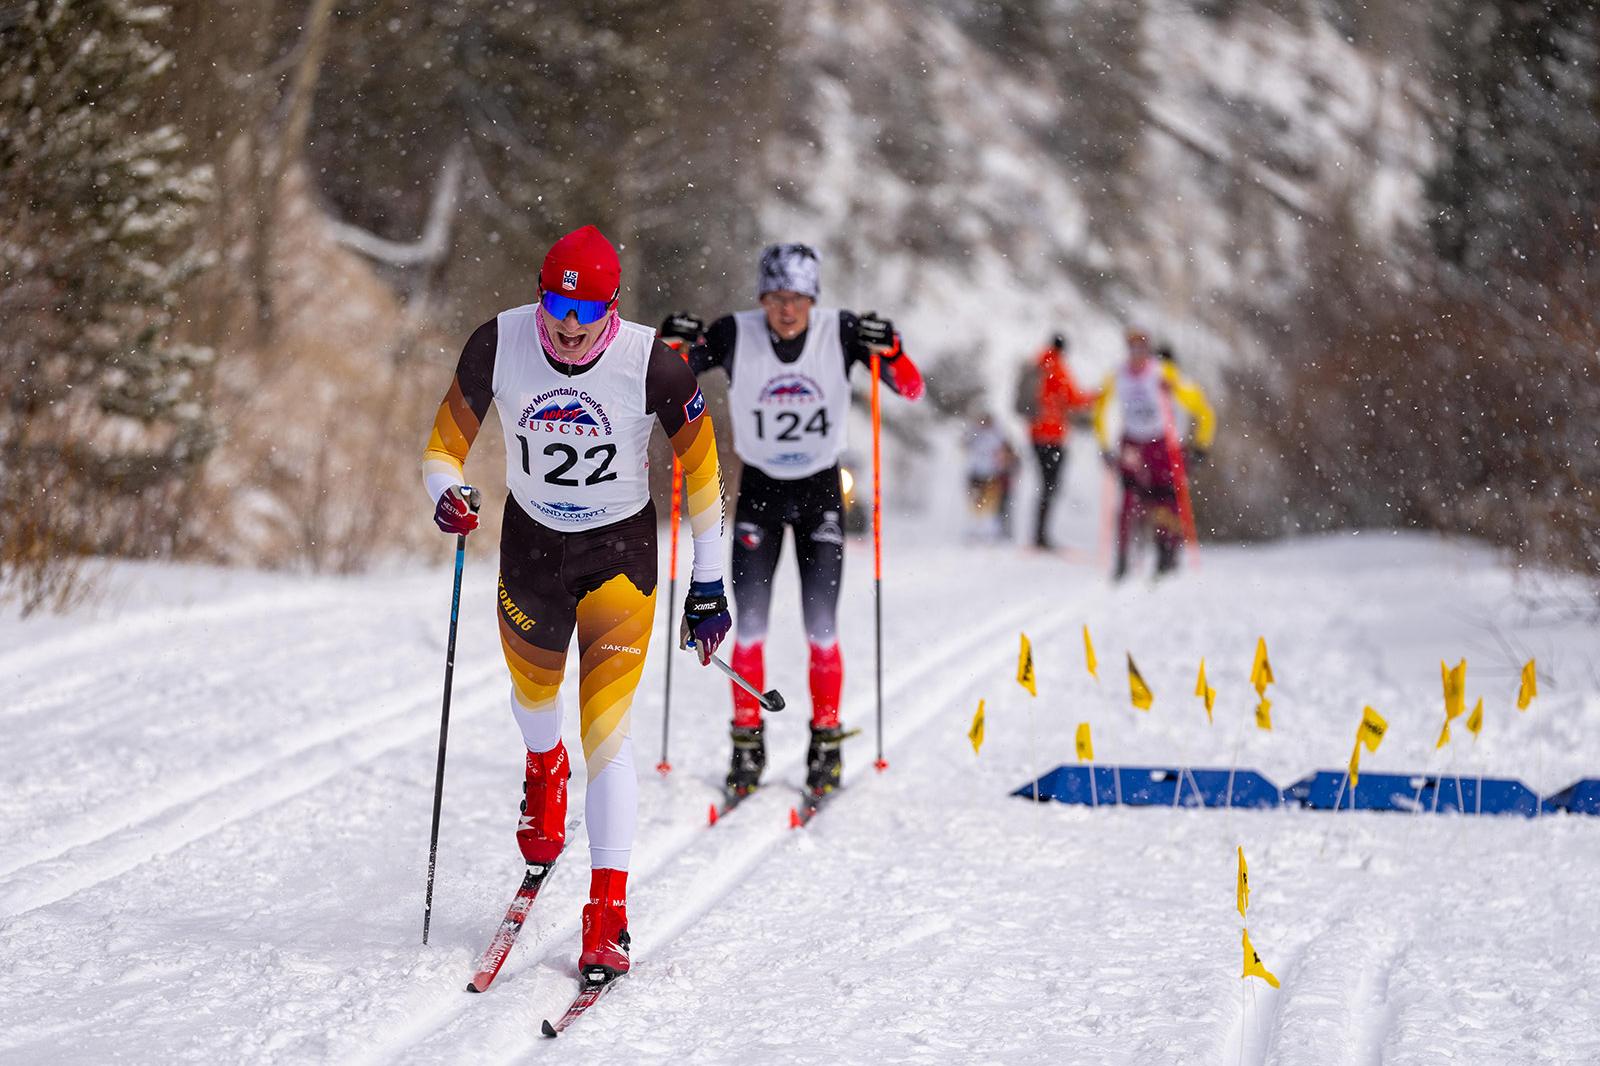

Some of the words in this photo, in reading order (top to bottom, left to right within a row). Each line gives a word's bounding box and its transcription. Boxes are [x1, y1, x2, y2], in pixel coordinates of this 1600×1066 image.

[564, 271, 577, 279] US
[518, 403, 536, 428] Rocky
[532, 387, 578, 406] Mountain
[579, 391, 612, 436] Conference
[752, 407, 832, 441] 124
[529, 420, 599, 437] USCSA
[515, 433, 618, 487] 122
[530, 500, 561, 517] GRAND
[562, 506, 607, 519] COUNTY
[498, 572, 536, 631] YOMING
[601, 643, 641, 655] JAKROO
